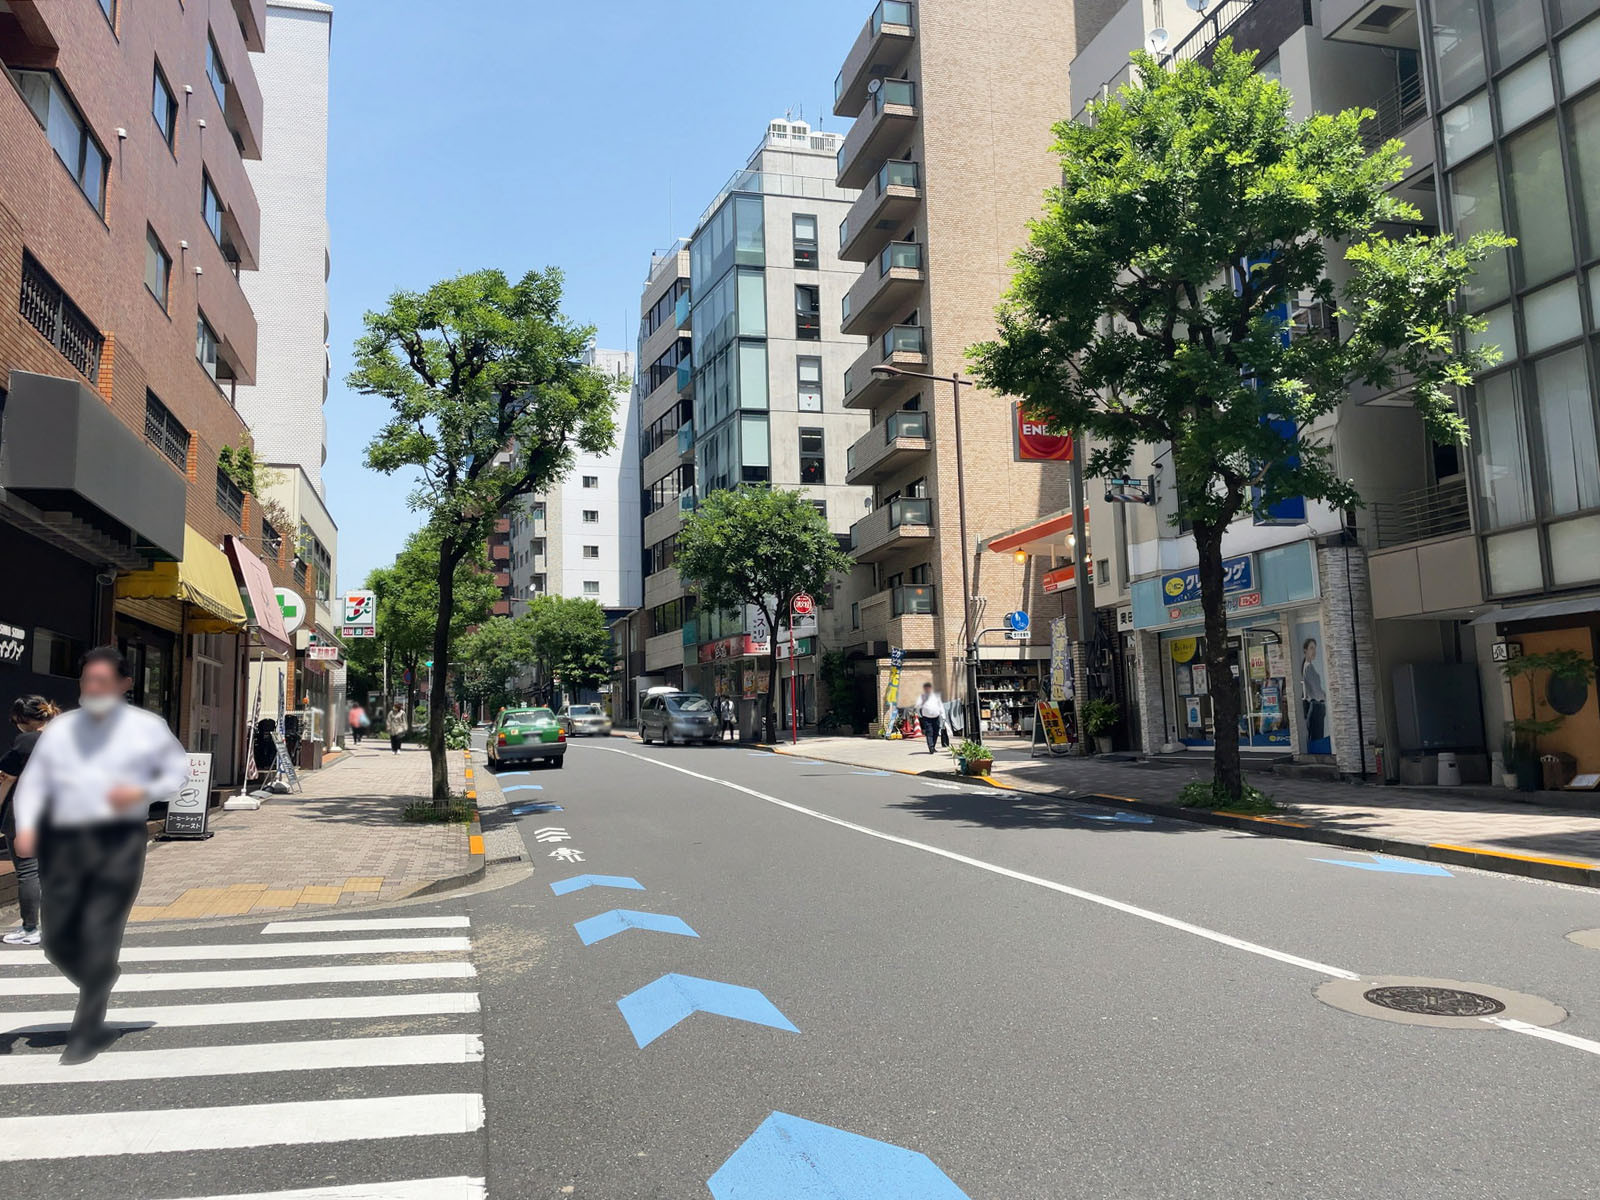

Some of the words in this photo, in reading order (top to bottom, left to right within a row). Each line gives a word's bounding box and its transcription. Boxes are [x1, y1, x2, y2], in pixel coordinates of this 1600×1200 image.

[1023, 424, 1067, 437] ENE
[1186, 561, 1245, 591] クリング
